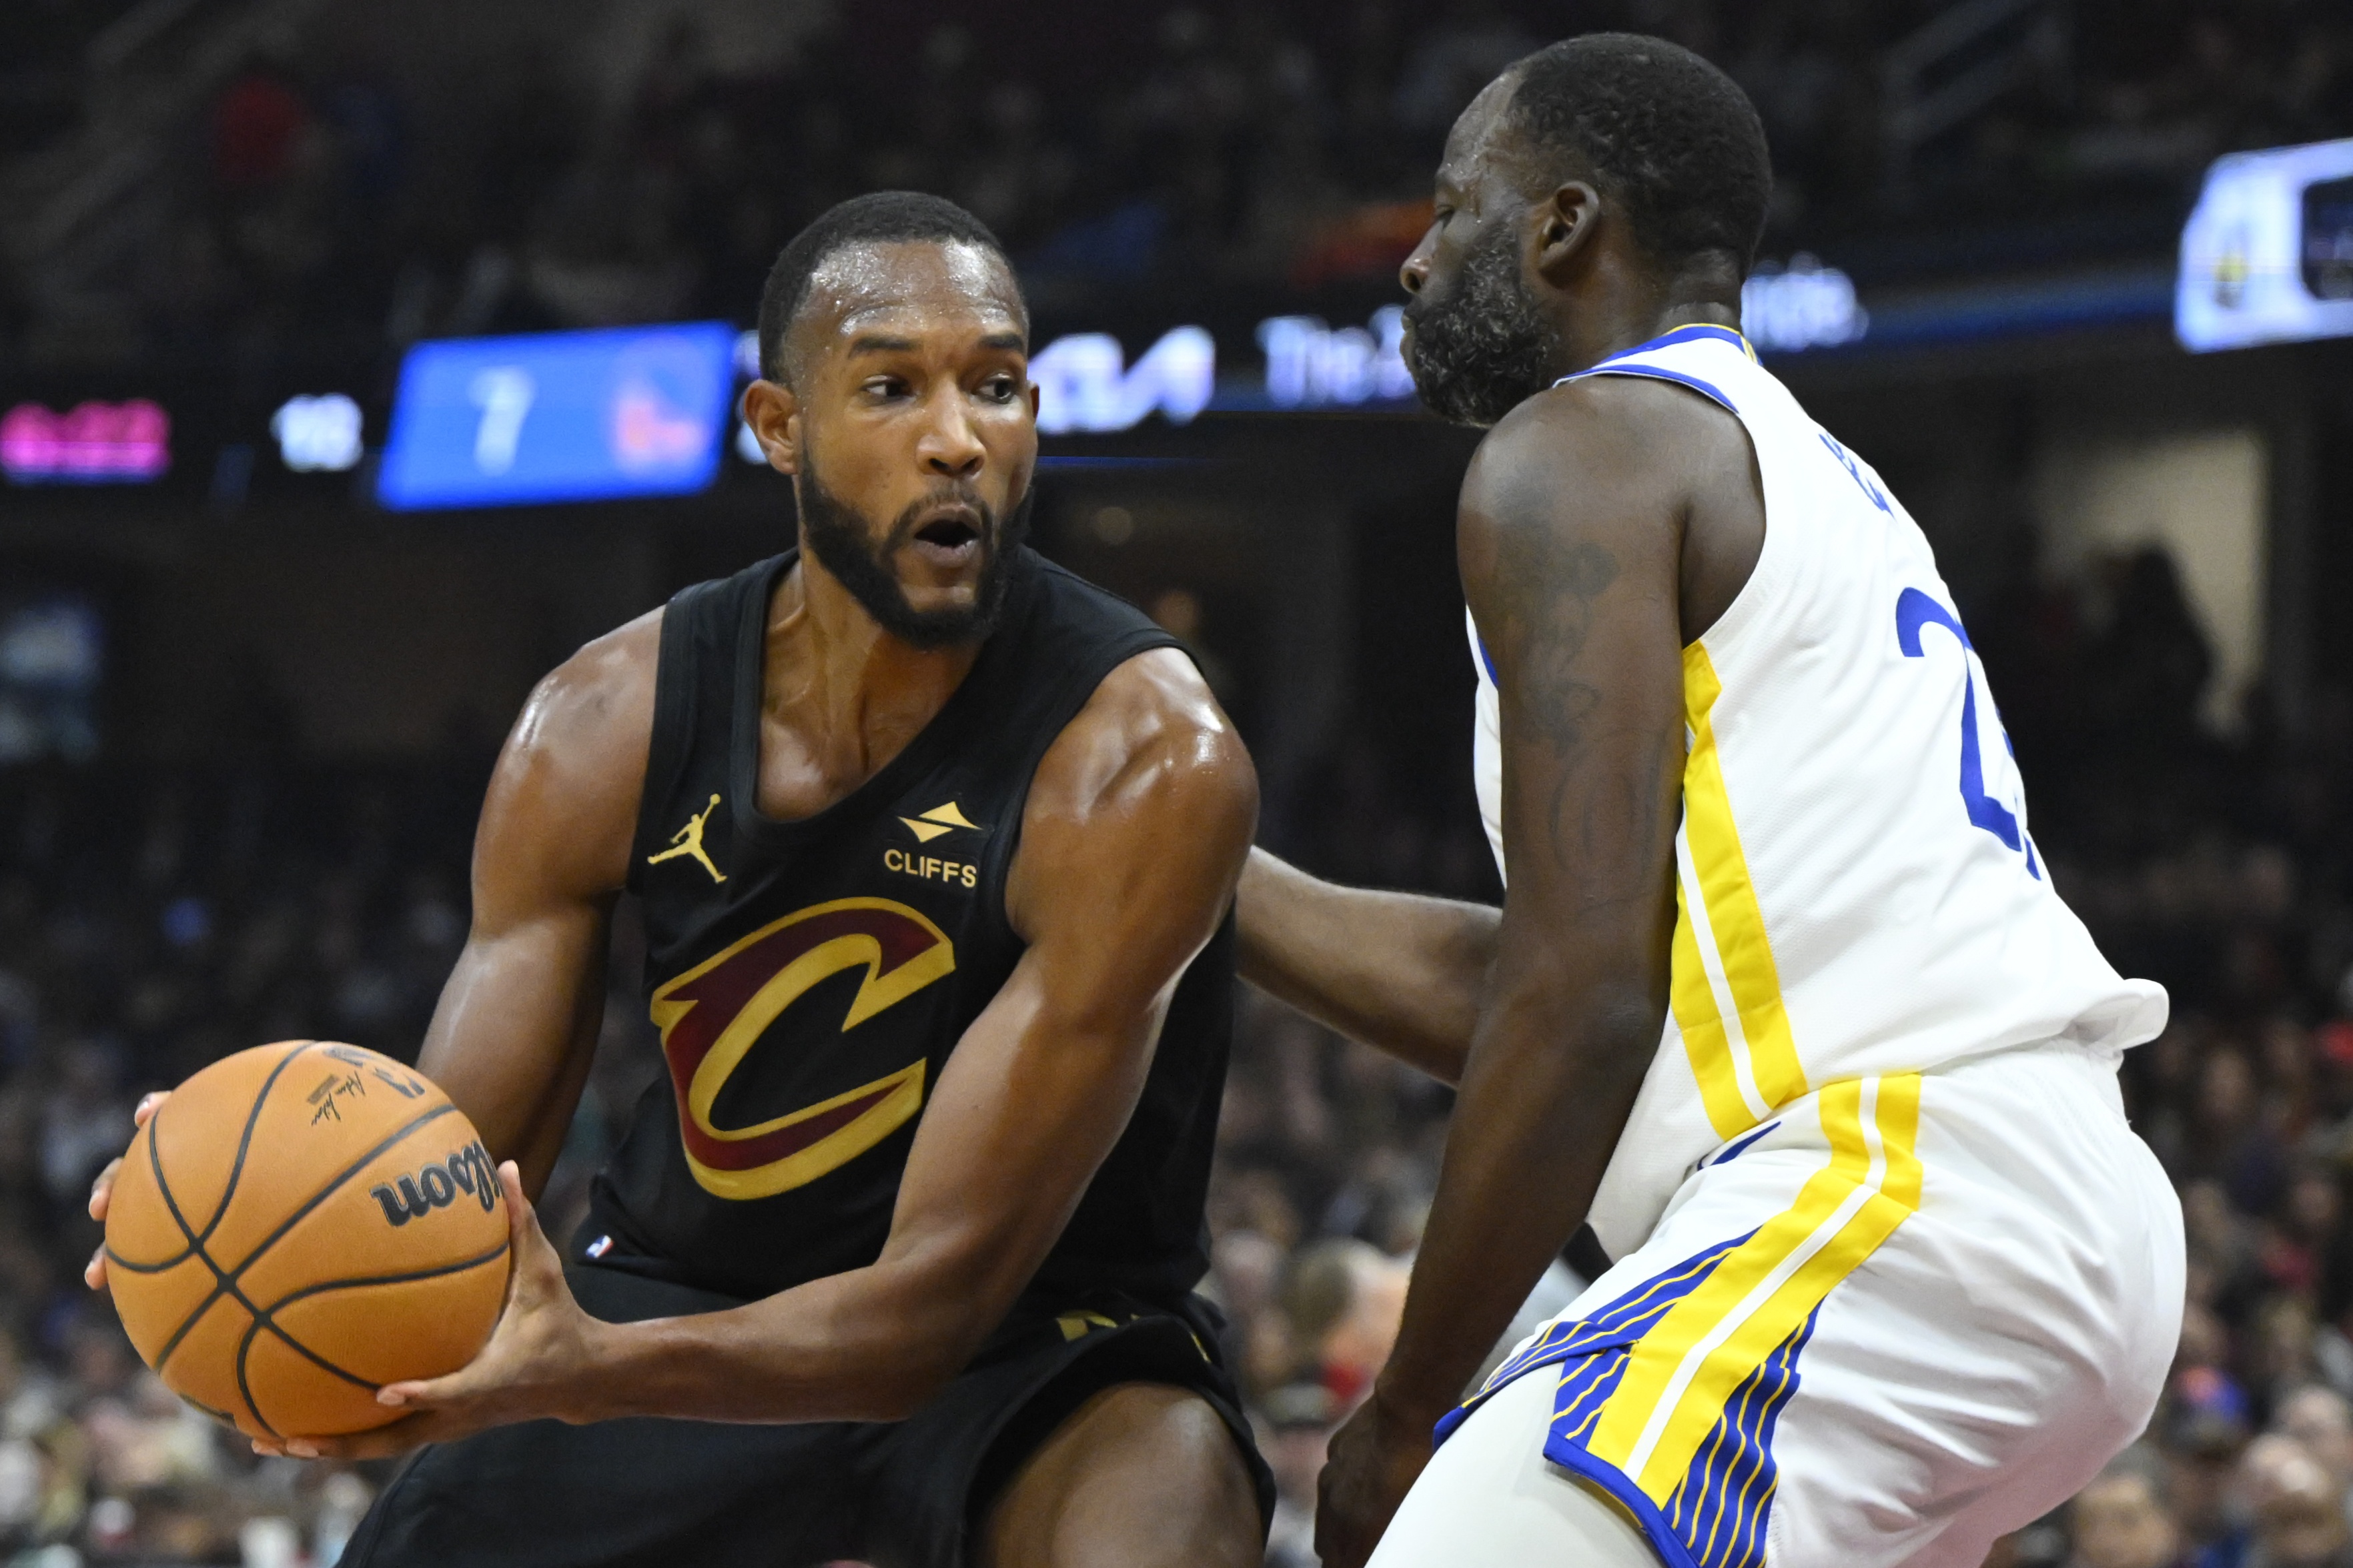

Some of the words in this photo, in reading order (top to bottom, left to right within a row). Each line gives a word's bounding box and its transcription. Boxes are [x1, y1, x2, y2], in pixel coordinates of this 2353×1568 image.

[1895, 586, 2041, 882] 2
[884, 848, 977, 888] CLIFFS
[650, 896, 957, 1201] C
[370, 1139, 501, 1227] ilson
